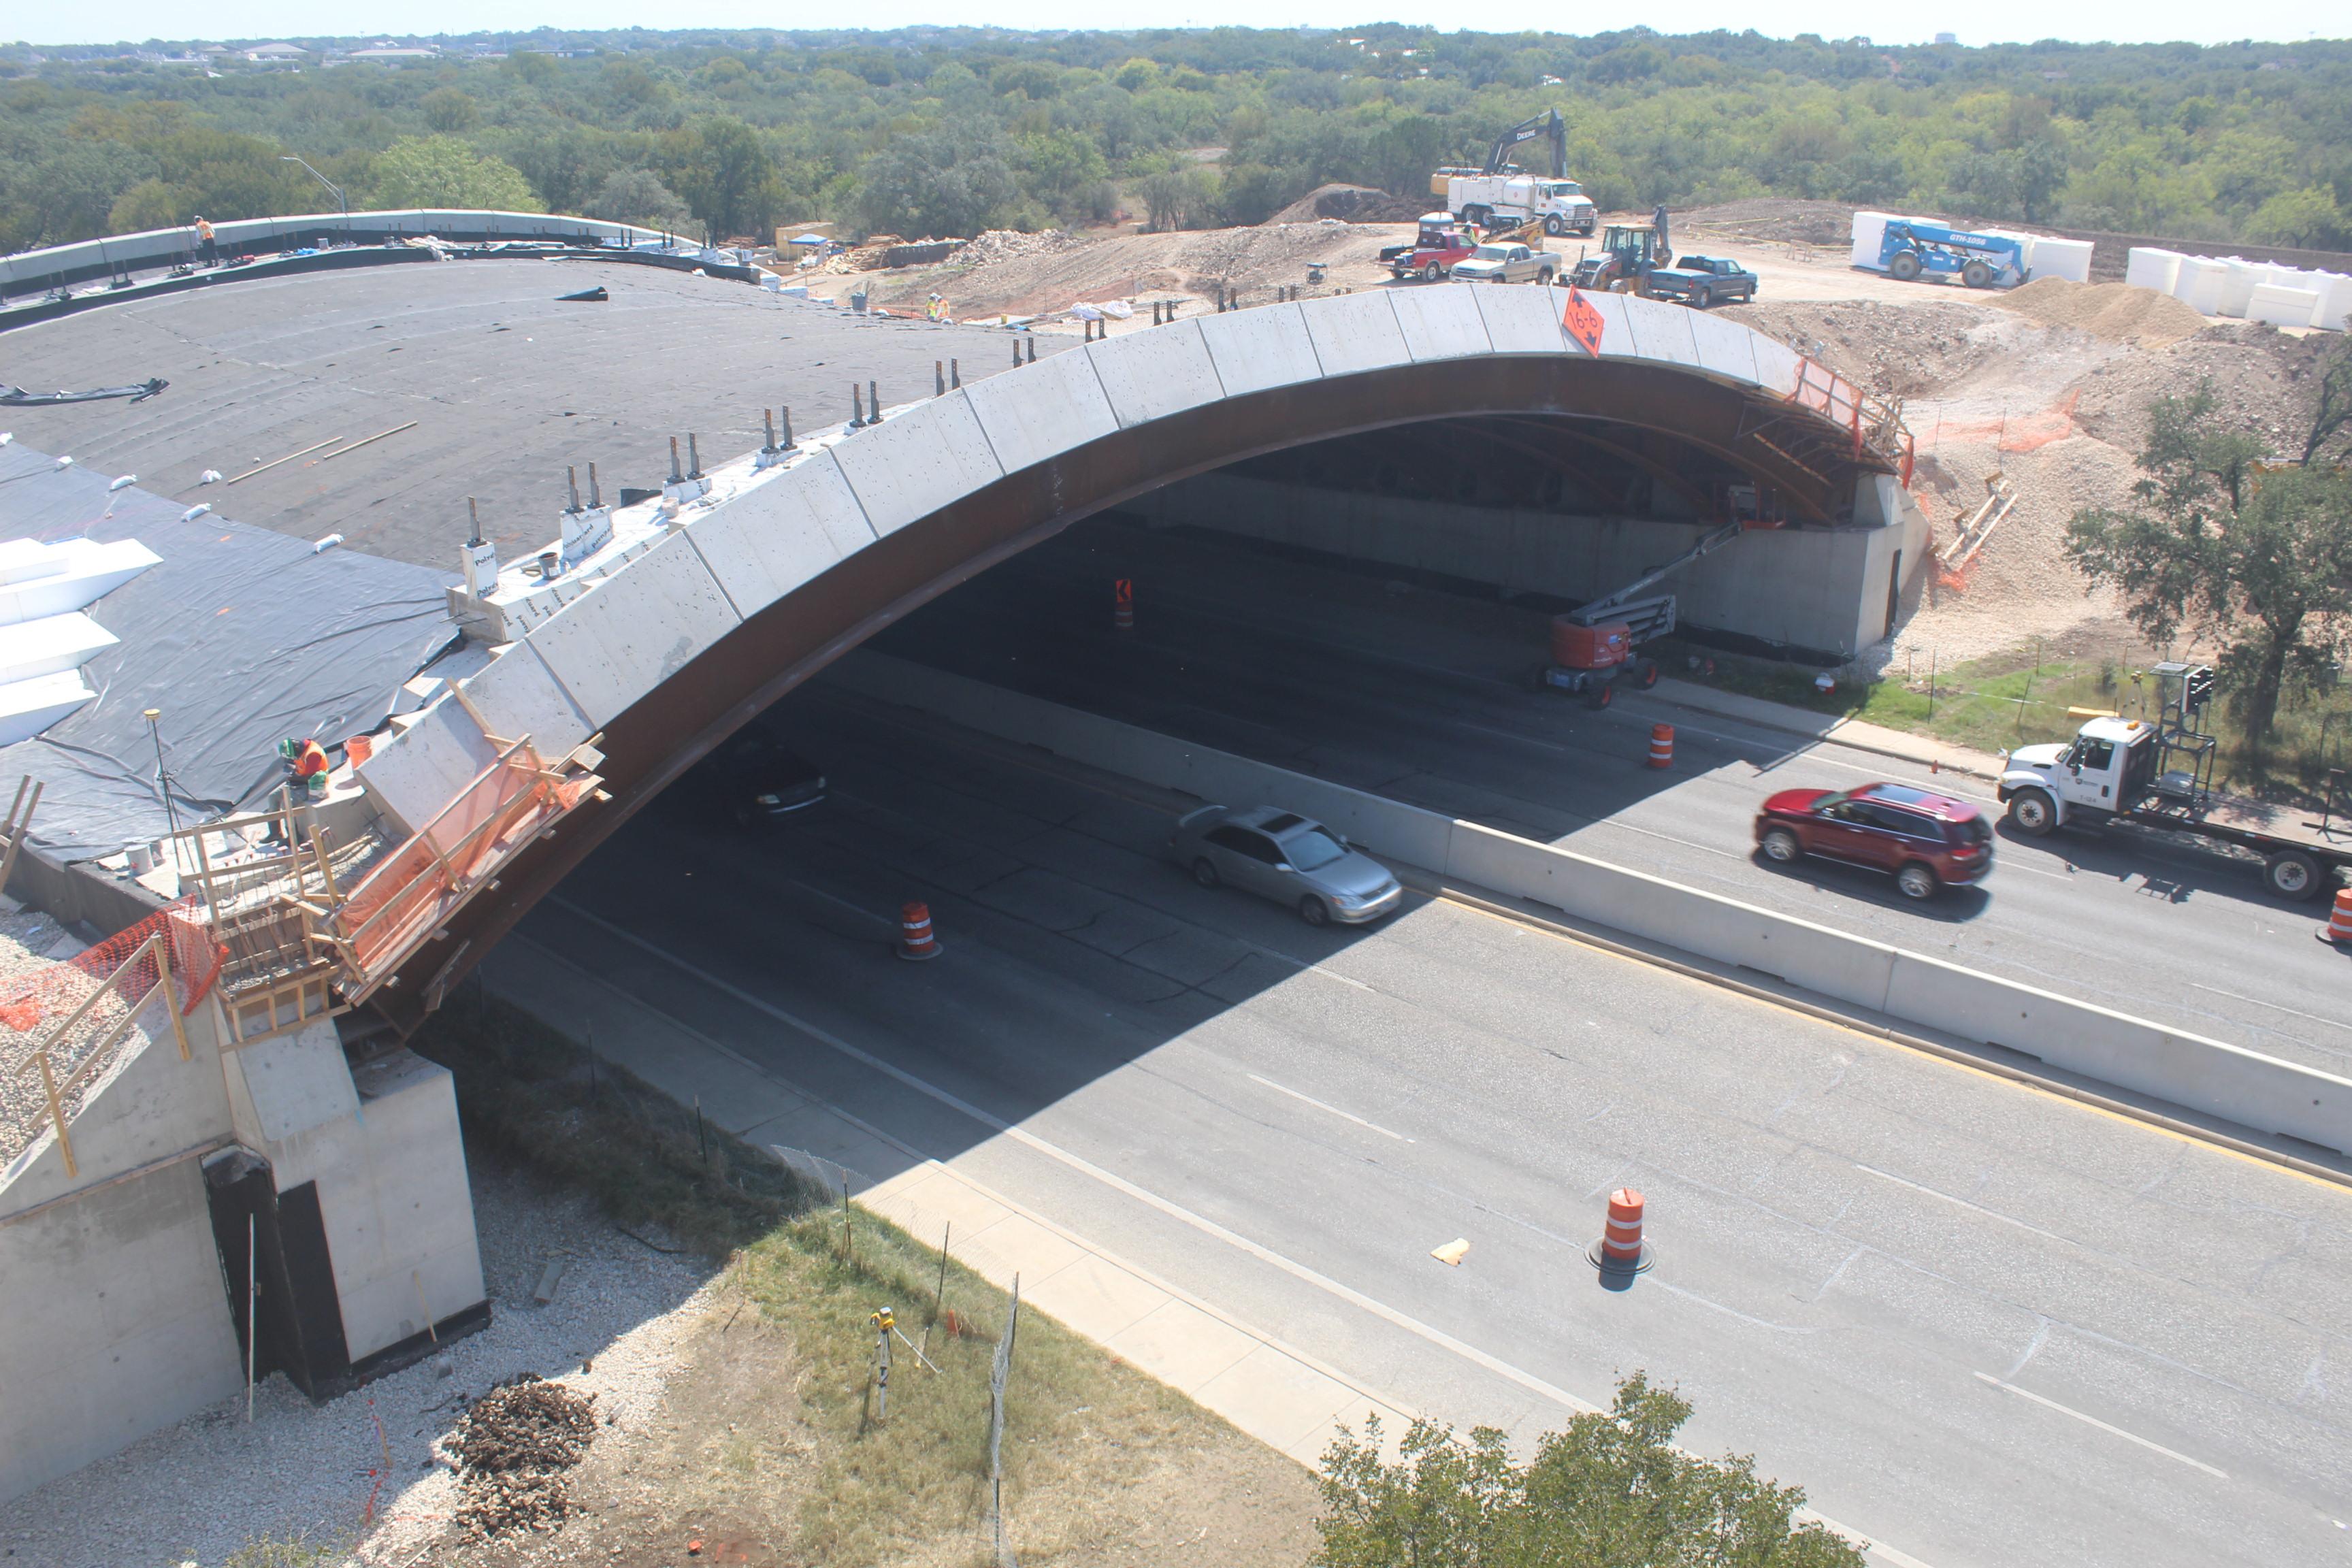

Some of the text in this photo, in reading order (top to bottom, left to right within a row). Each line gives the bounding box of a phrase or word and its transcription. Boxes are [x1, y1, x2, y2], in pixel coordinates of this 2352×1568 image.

[1516, 129, 1536, 141] DEERE
[1949, 233, 1987, 246] GTH-1056
[1569, 310, 1598, 329] 16-6
